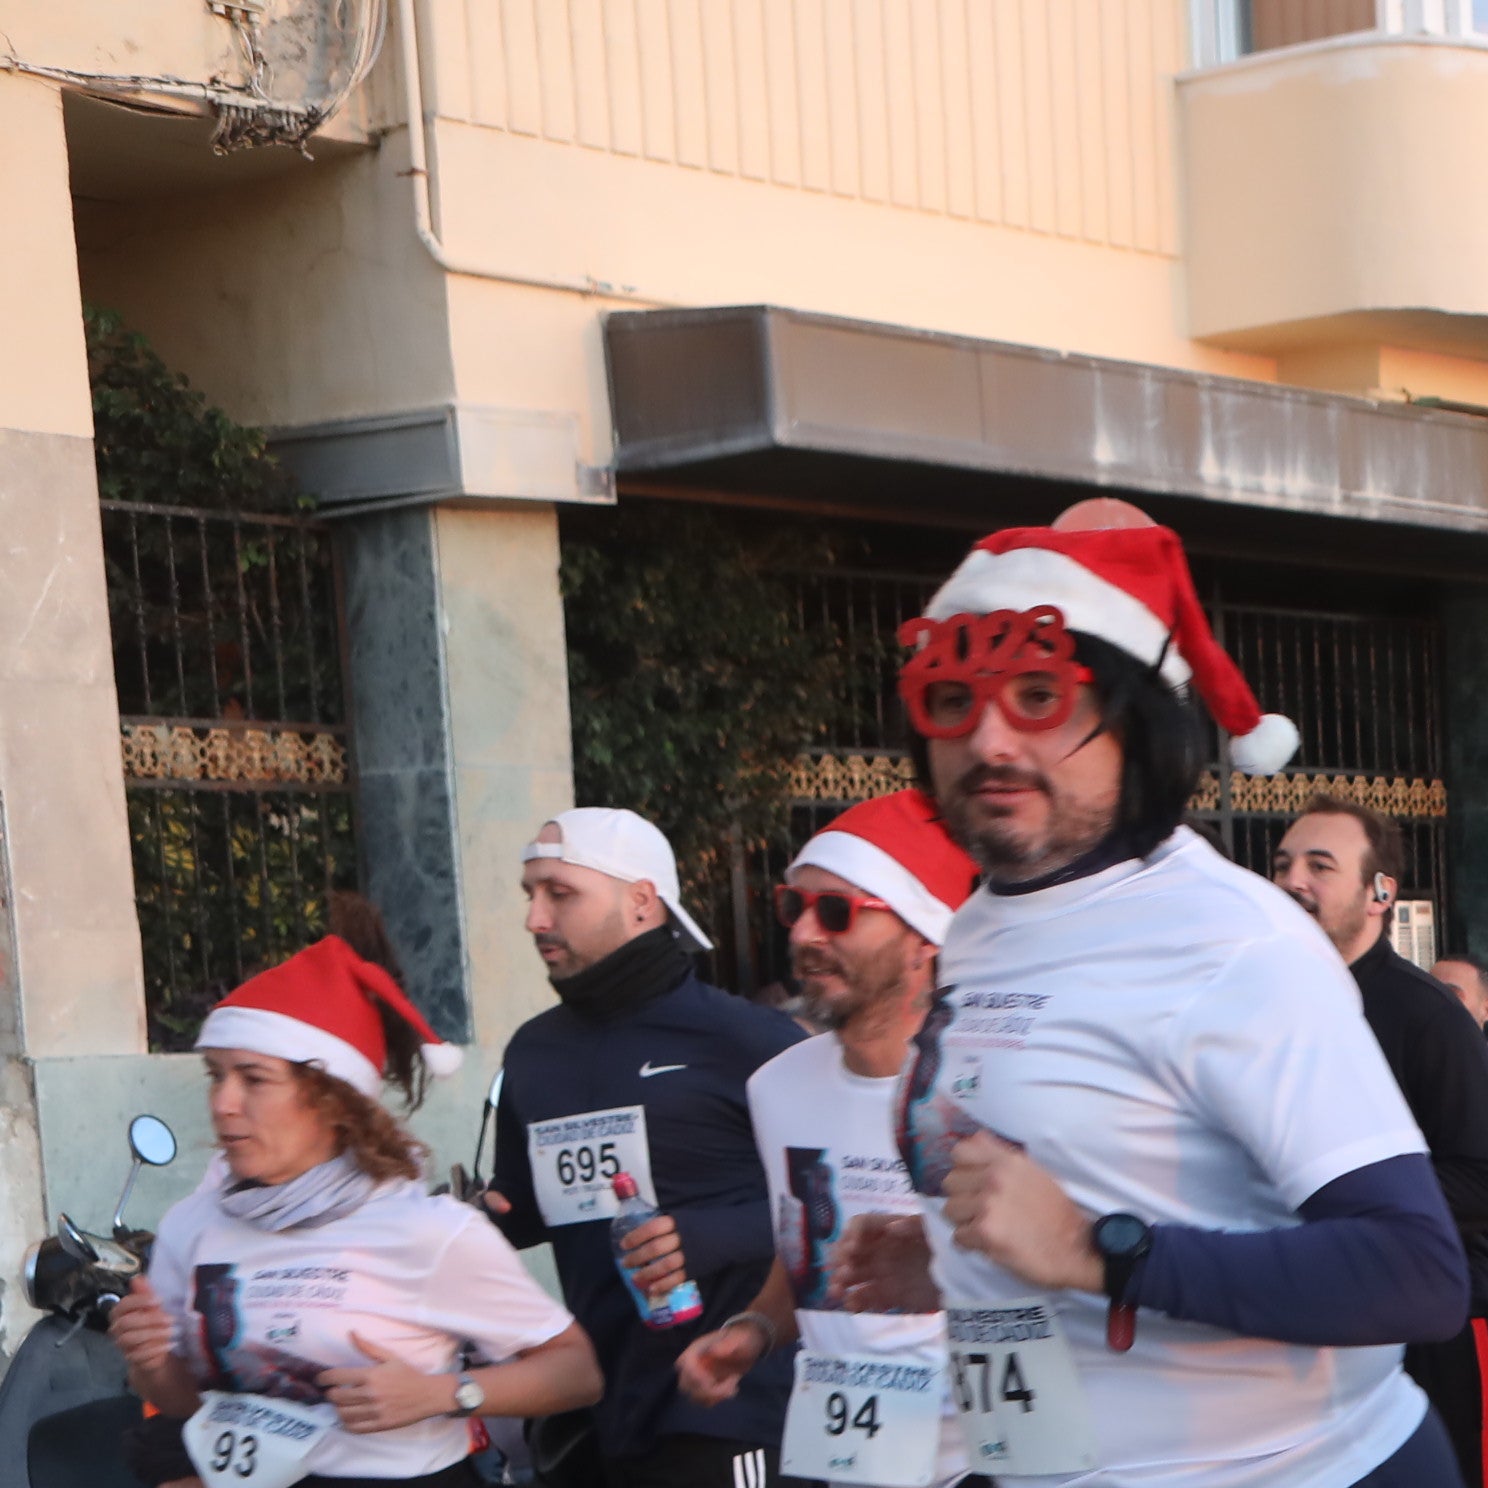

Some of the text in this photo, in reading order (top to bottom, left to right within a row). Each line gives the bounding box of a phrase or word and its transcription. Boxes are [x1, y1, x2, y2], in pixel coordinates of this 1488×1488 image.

[898, 605, 1076, 678] 2023
[557, 1143, 620, 1186] 695
[826, 1391, 882, 1439] 94
[210, 1431, 257, 1477] 93
